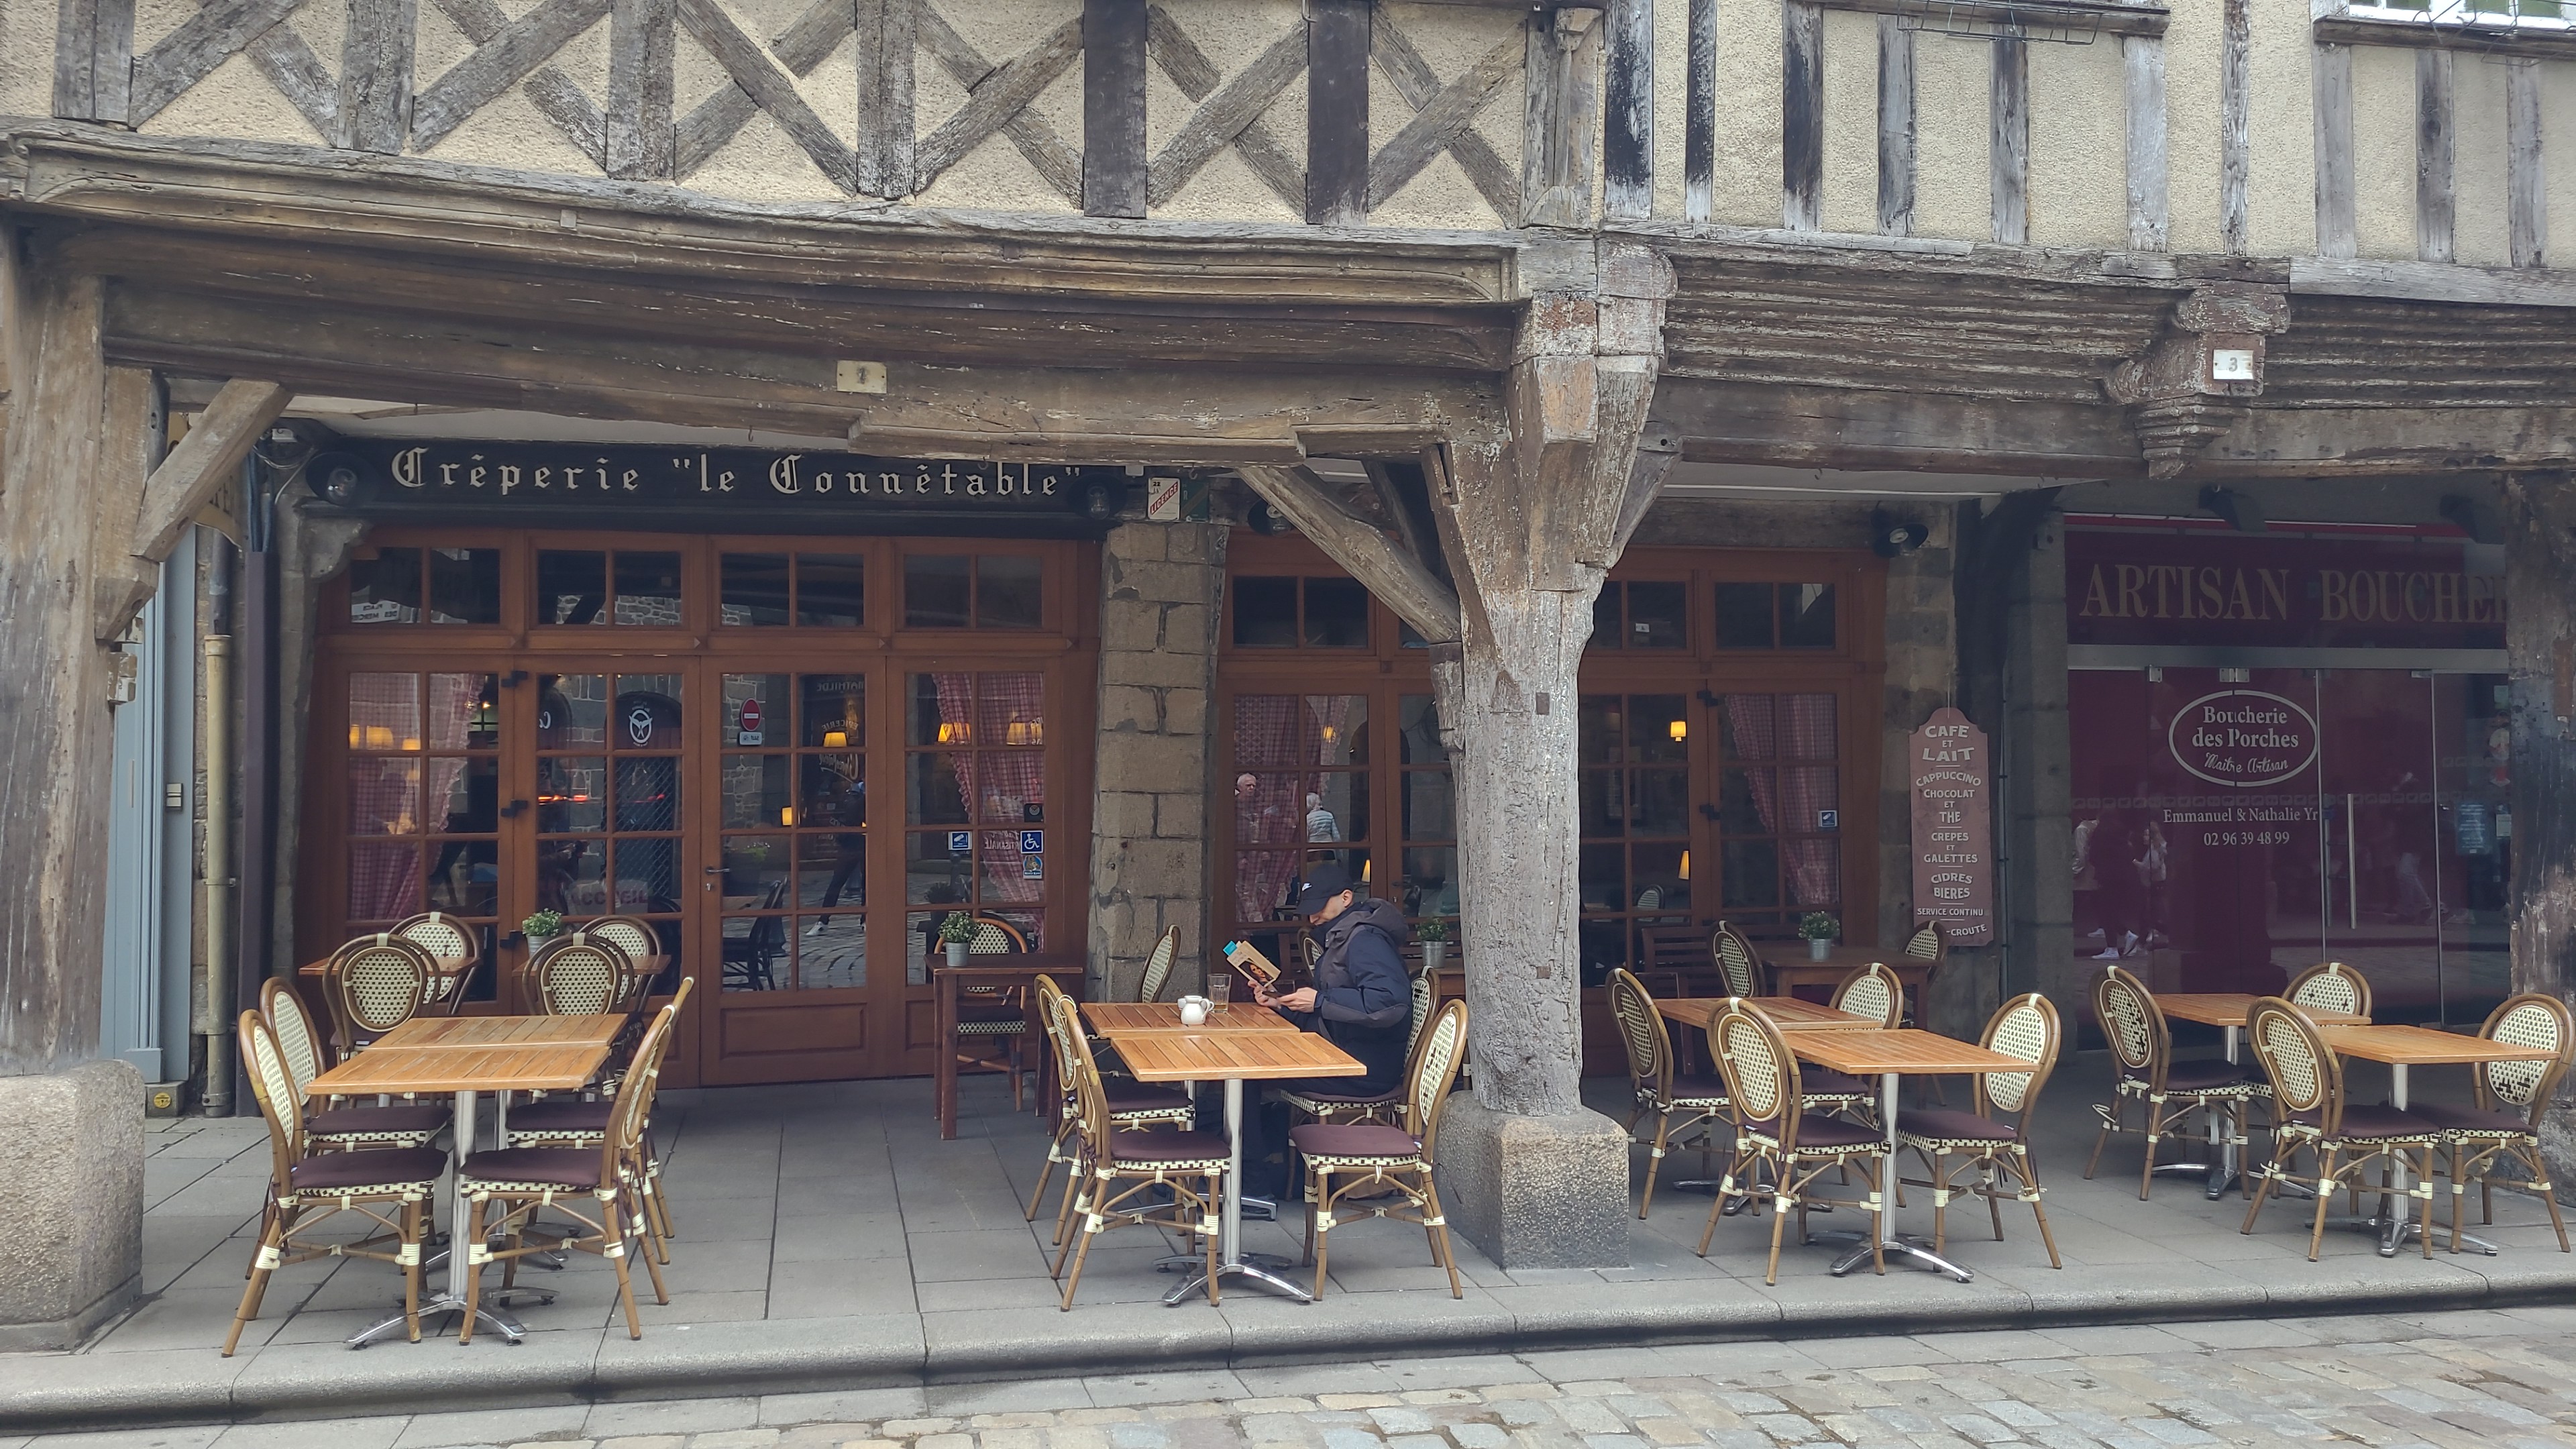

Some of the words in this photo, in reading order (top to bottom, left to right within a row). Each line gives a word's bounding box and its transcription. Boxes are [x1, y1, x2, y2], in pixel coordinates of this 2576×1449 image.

[2228, 357, 2239, 372] 3
[1150, 484, 1179, 515] LICENCE
[2079, 564, 2290, 621] ARTISAN
[2203, 706, 2288, 724] Boucherie
[1925, 725, 1970, 738] CAFE
[2192, 727, 2223, 747] des
[2227, 728, 2299, 748] Porches
[1922, 747, 1975, 761] LAIT
[2247, 757, 2289, 773] Artisan
[1916, 771, 1982, 786] CAPPUCCINO
[1923, 789, 1976, 798] CHOCOLAT
[1939, 812, 1962, 823] THE
[2163, 808, 2233, 822] Emmanuel
[2237, 808, 2246, 822] &
[2249, 807, 2301, 821] Nathalie
[1931, 833, 1970, 841] CREPES
[2204, 833, 2219, 846] 02
[2222, 833, 2237, 845] 96
[2241, 832, 2254, 845] 39
[2257, 832, 2271, 845] 48
[2274, 832, 2290, 844] 99
[1923, 854, 1978, 863] GALETTES
[1931, 873, 1973, 884] CIDRES
[571, 890, 648, 906] ACCEIL
[1933, 888, 1971, 900] BIERES
